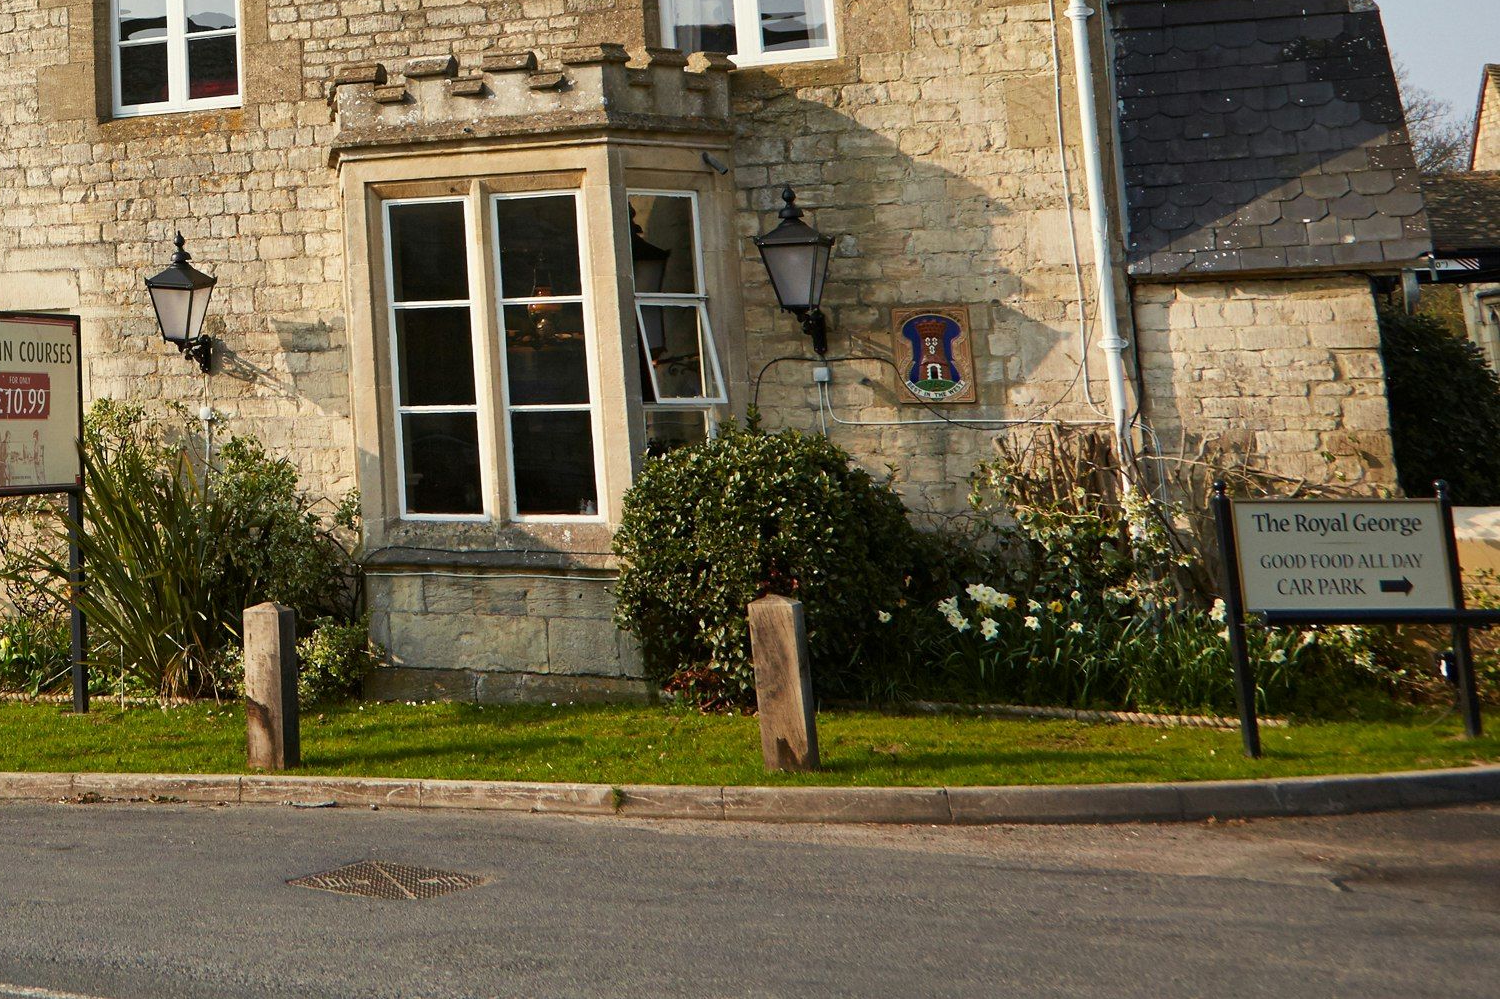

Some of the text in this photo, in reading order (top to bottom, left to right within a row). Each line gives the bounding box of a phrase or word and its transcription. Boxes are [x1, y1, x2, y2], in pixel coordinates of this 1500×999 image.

[19, 340, 72, 364] COURSES
[9, 375, 31, 385] FOR ONLY
[906, 381, 921, 394] BEST
[948, 381, 964, 395] WEST
[1251, 512, 1422, 537] The Royal George
[1260, 553, 1423, 569] GOOD FOOD ALL DAY
[1277, 577, 1367, 596] CAR PARK
